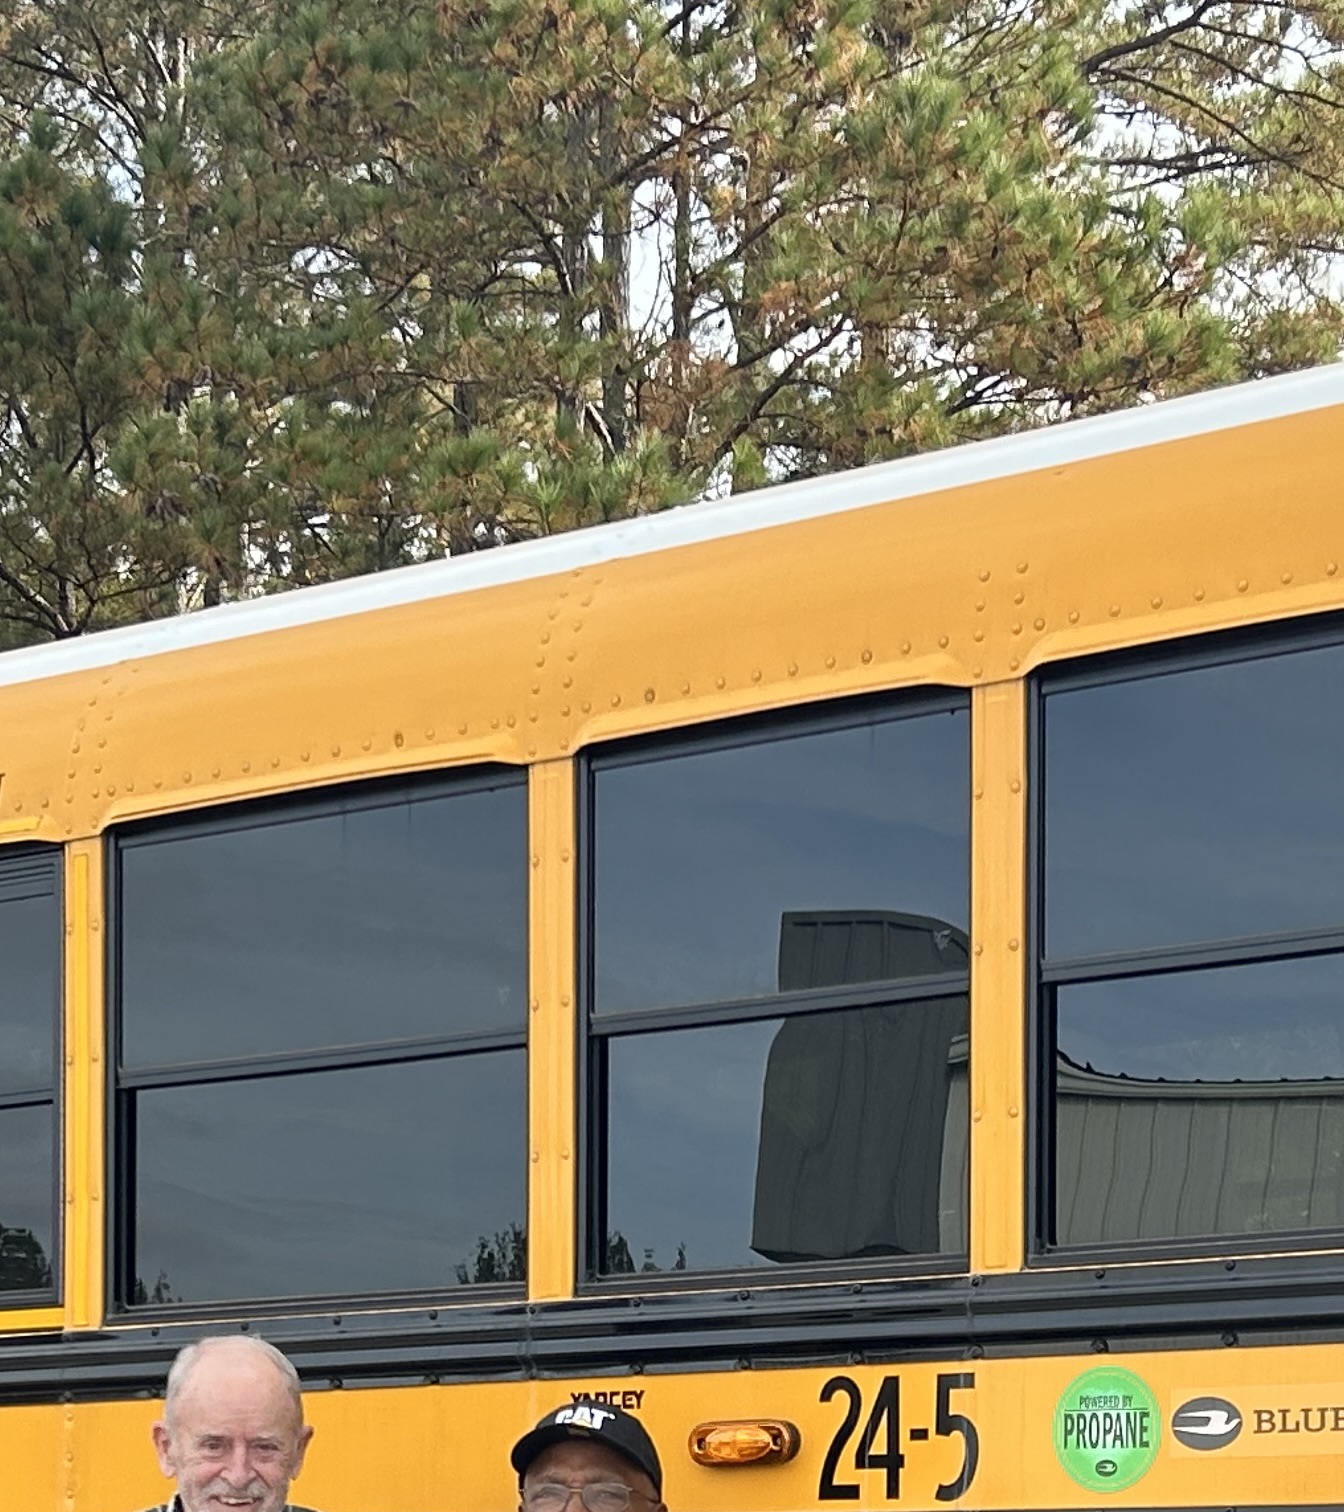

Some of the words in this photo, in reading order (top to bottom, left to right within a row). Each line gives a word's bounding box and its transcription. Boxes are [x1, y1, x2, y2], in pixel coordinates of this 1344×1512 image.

[1079, 1394, 1120, 1409] POWERED
[1122, 1394, 1133, 1408] BY
[555, 1406, 606, 1430] CAT
[1063, 1411, 1150, 1450] PROPANE
[818, 1372, 979, 1502] 24-5
